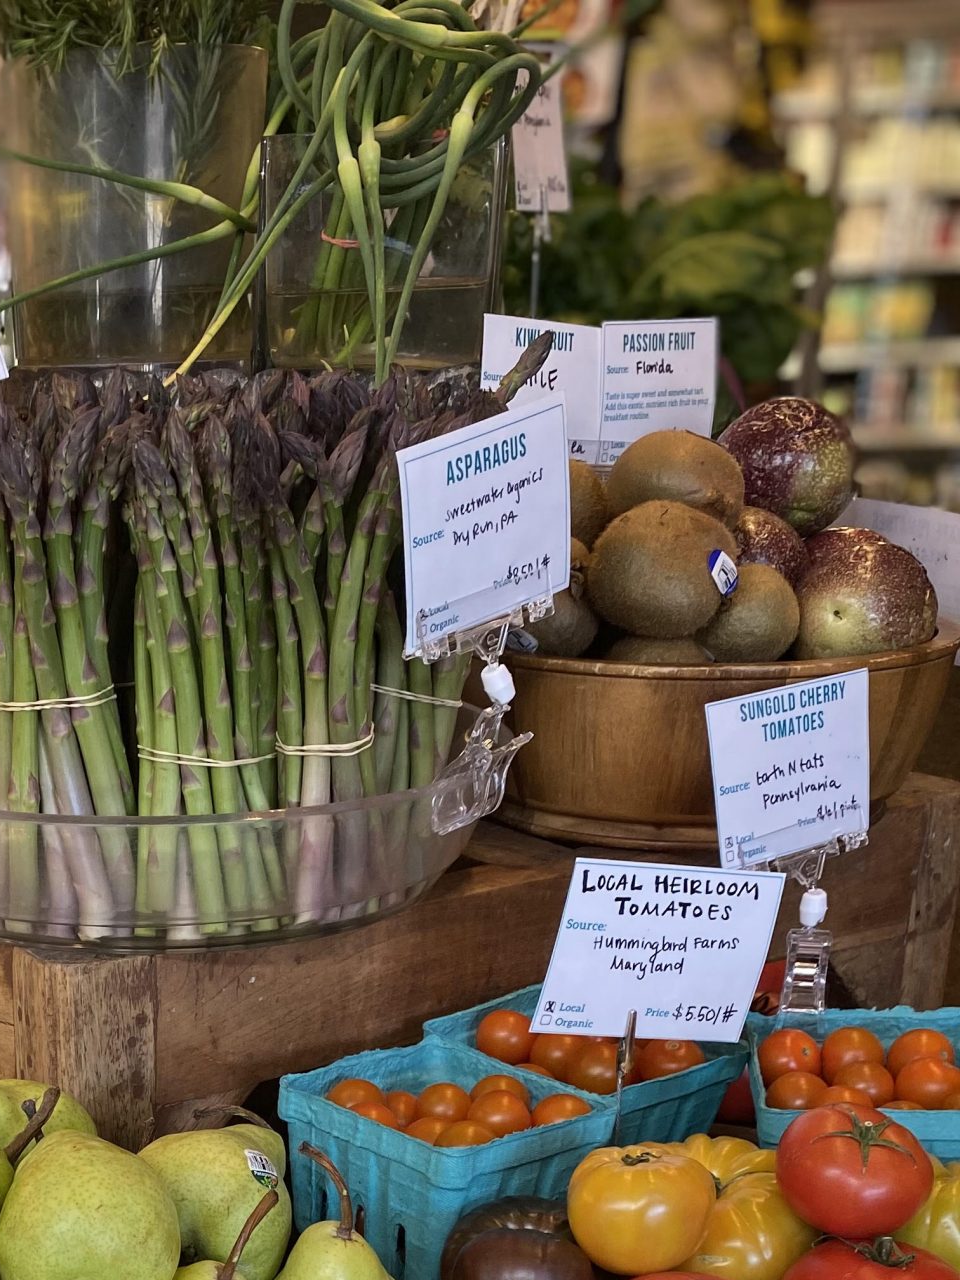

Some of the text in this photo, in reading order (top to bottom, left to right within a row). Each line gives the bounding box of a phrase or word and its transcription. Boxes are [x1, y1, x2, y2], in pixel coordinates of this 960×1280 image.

[550, 330, 575, 352] RUIT
[623, 331, 696, 352] PASSION FRUIT
[636, 358, 674, 375] Florida
[446, 432, 527, 486] ASPARAGUS
[412, 529, 445, 548] Source:
[430, 615, 459, 633] Organic
[740, 680, 847, 723] SUNGOLD CHERRY
[762, 710, 825, 742] TOMATOES
[719, 780, 751, 797] Source:
[581, 869, 760, 901] LOCAL HEIRLOOM
[614, 896, 733, 921] TOMATOES
[565, 918, 608, 932] Source:
[593, 935, 740, 962] Hummingbird Farms
[609, 956, 685, 980] Maryland
[558, 1001, 586, 1013] Local
[644, 1007, 670, 1018] Price
[554, 1016, 594, 1029] Organic
